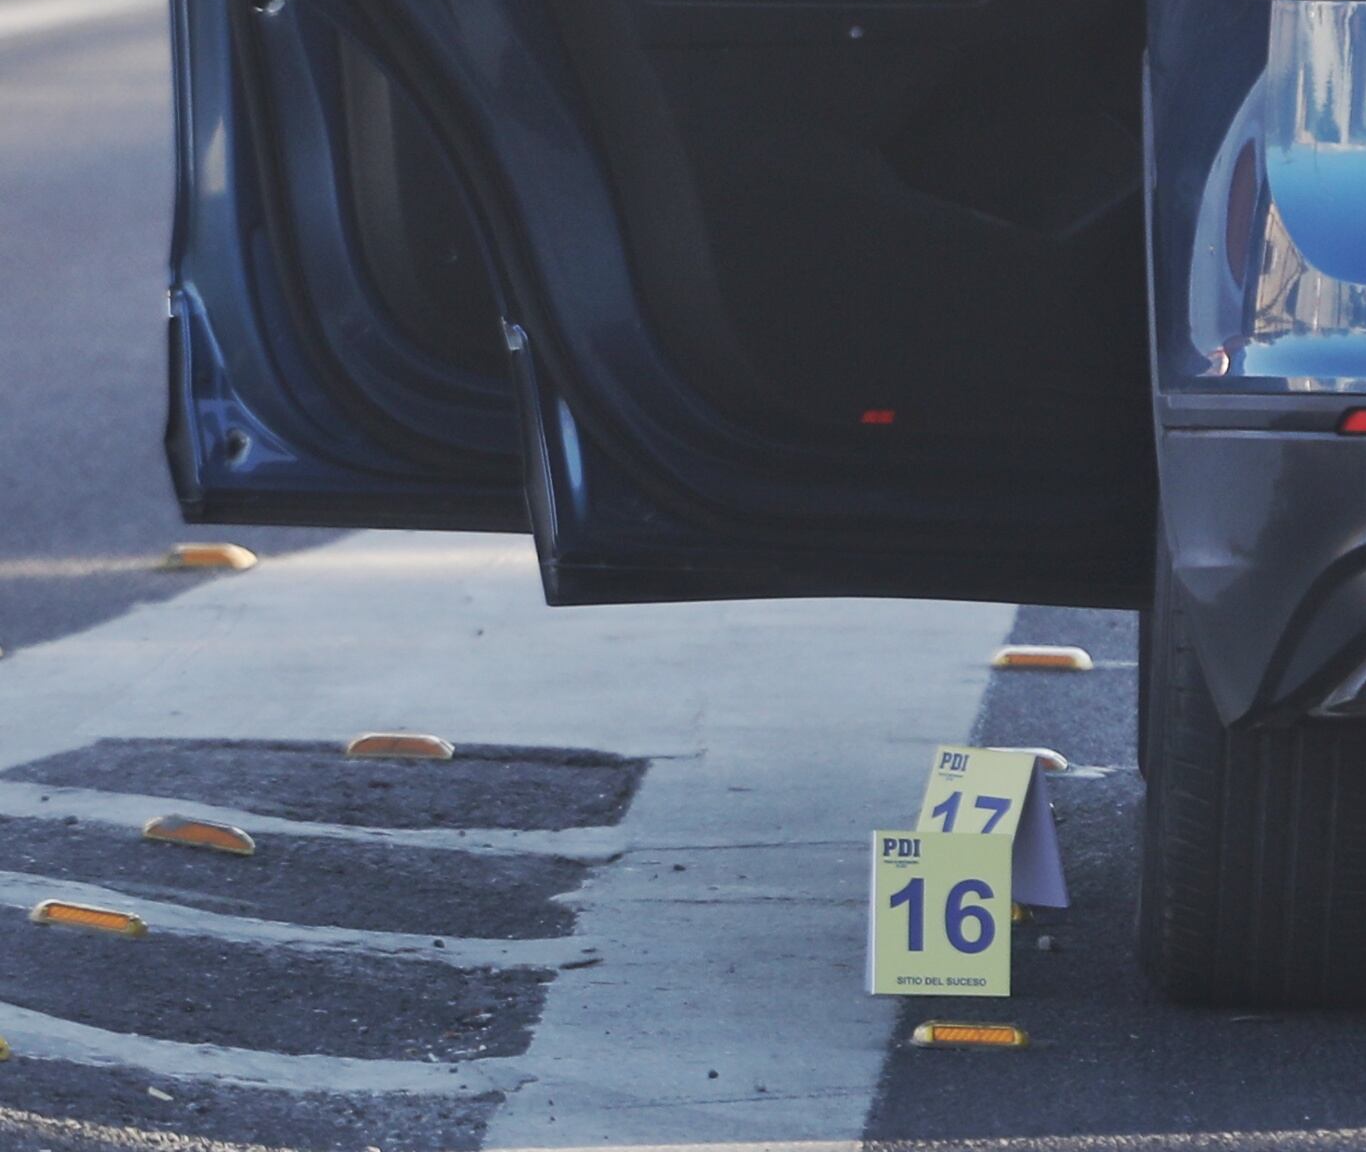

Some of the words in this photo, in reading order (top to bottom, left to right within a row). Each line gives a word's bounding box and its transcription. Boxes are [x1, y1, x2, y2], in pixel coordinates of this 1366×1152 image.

[939, 752, 969, 772] PDI
[932, 791, 1012, 834] 17
[883, 838, 921, 857] PDI
[890, 878, 995, 954] 16
[897, 976, 922, 985] SITIO
[925, 976, 944, 986] DEL
[946, 977, 987, 987] SUCESO
